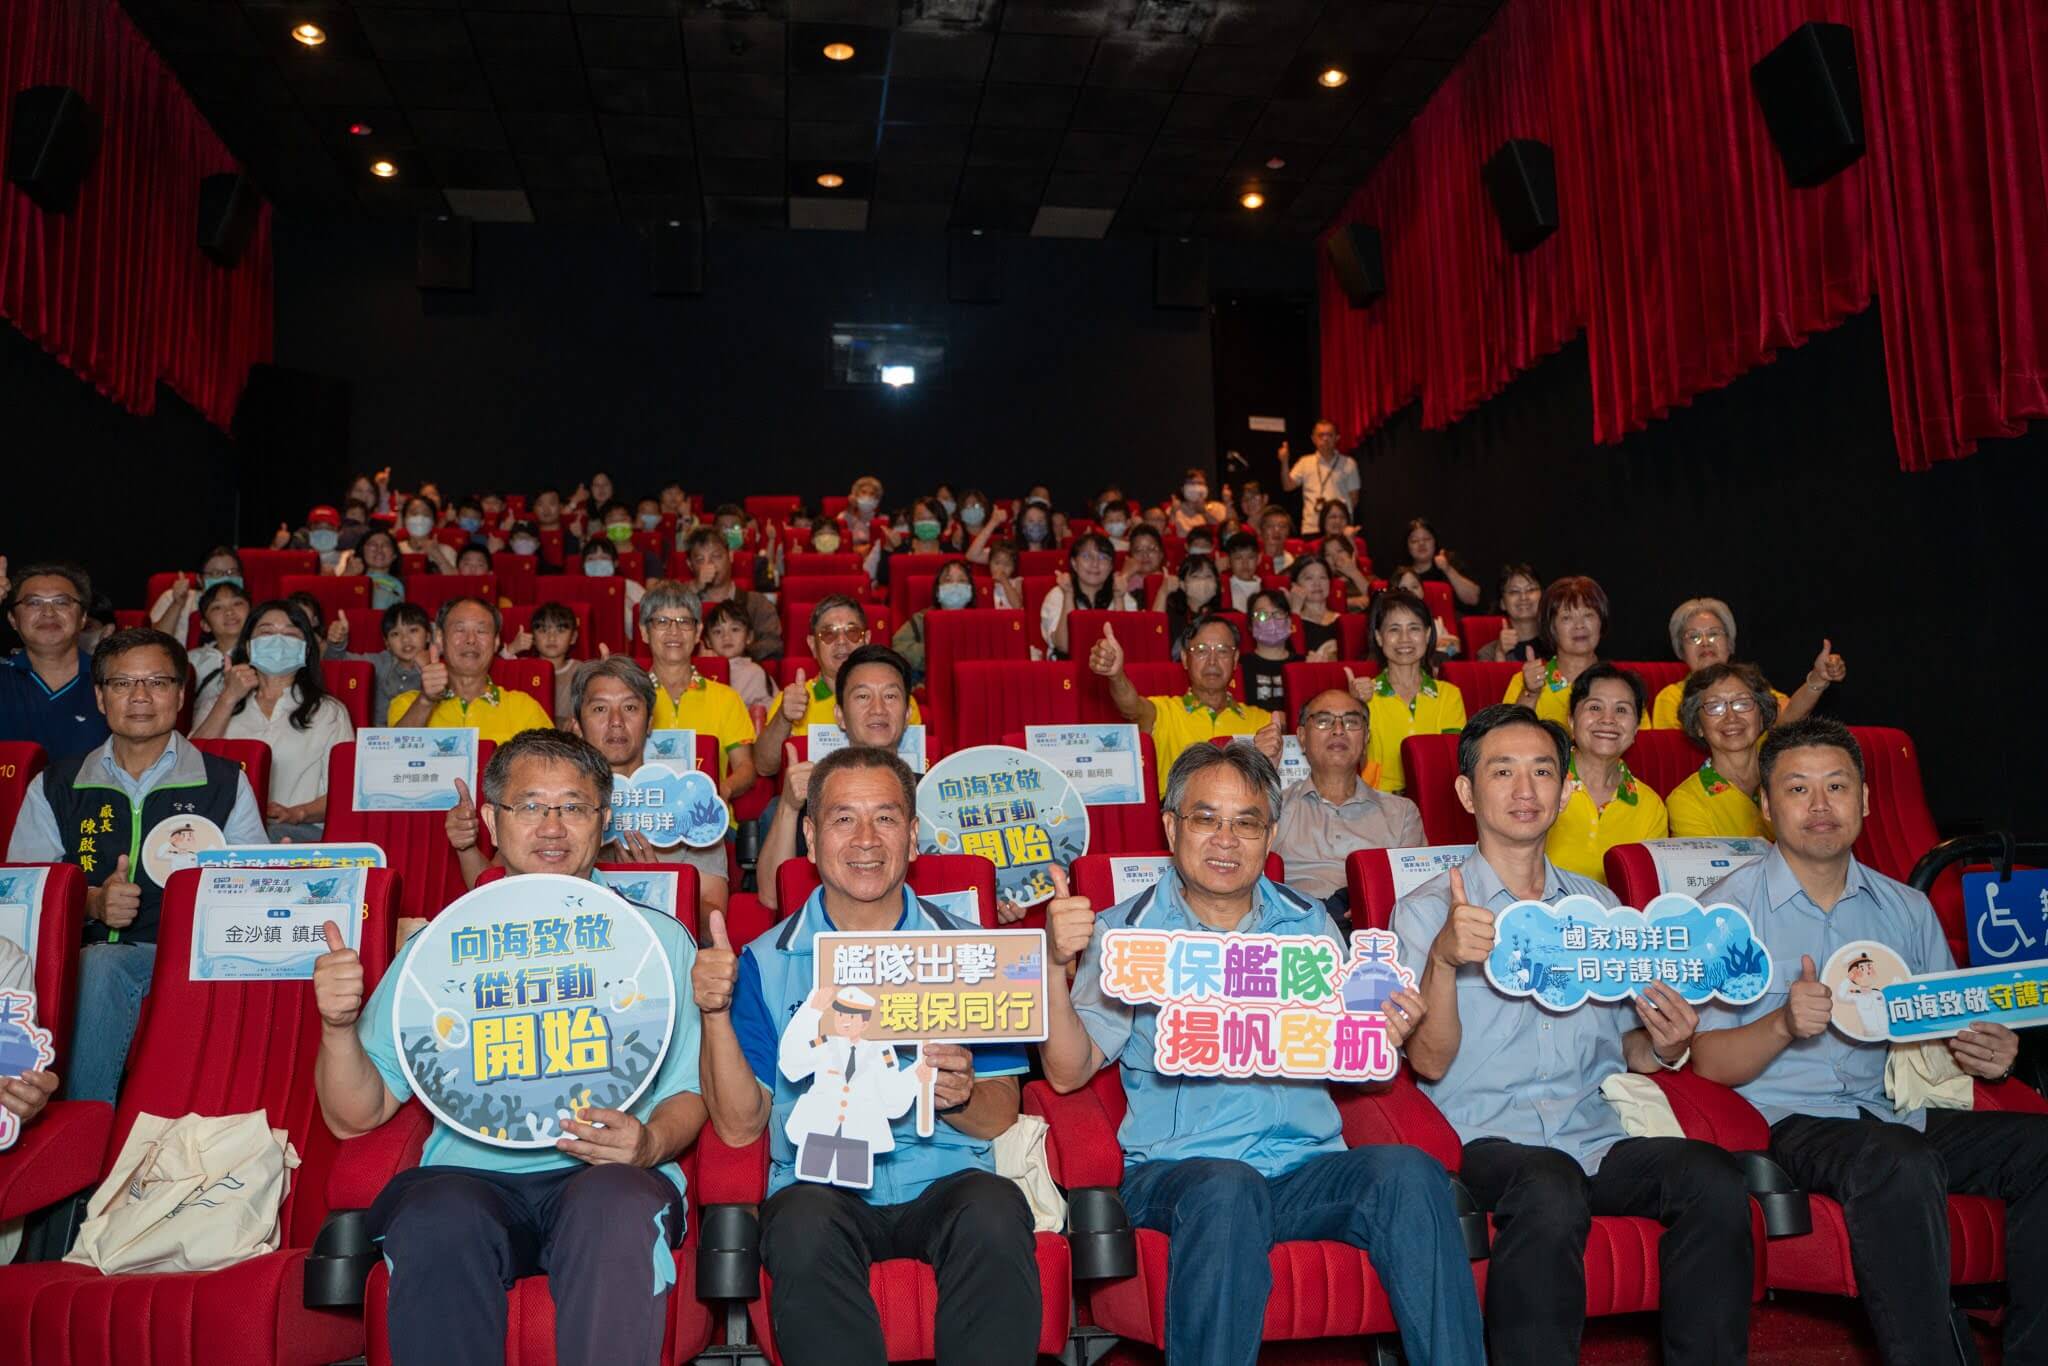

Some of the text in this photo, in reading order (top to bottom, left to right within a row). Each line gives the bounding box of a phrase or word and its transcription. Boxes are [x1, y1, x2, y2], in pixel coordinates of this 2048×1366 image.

[876, 620, 885, 630] 6
[1155, 624, 1163, 634] 4
[531, 675, 541, 687] 8
[1063, 679, 1071, 690] 5
[1229, 678, 1236, 689] 4
[696, 758, 704, 770] 7
[1901, 746, 1908, 759] 1
[0, 764, 16, 778] 10
[936, 767, 1043, 803] 向海致敬
[99, 804, 114, 833] 廠長
[603, 811, 676, 832] 護海洋
[957, 797, 1037, 830] 從行動
[957, 823, 1056, 870] 開始
[225, 925, 327, 944] 金沙鎮 鎮長
[450, 912, 614, 966] 向海致敬
[1563, 925, 1692, 952] 國家海洋日
[832, 943, 997, 986] 艦隊出擊
[1111, 939, 1335, 1001] 環保艦隊
[1551, 958, 1706, 984] 一同守護海洋
[472, 963, 598, 1013] 從行動
[879, 990, 1035, 1032] 環保同行
[470, 1005, 613, 1086] 開始
